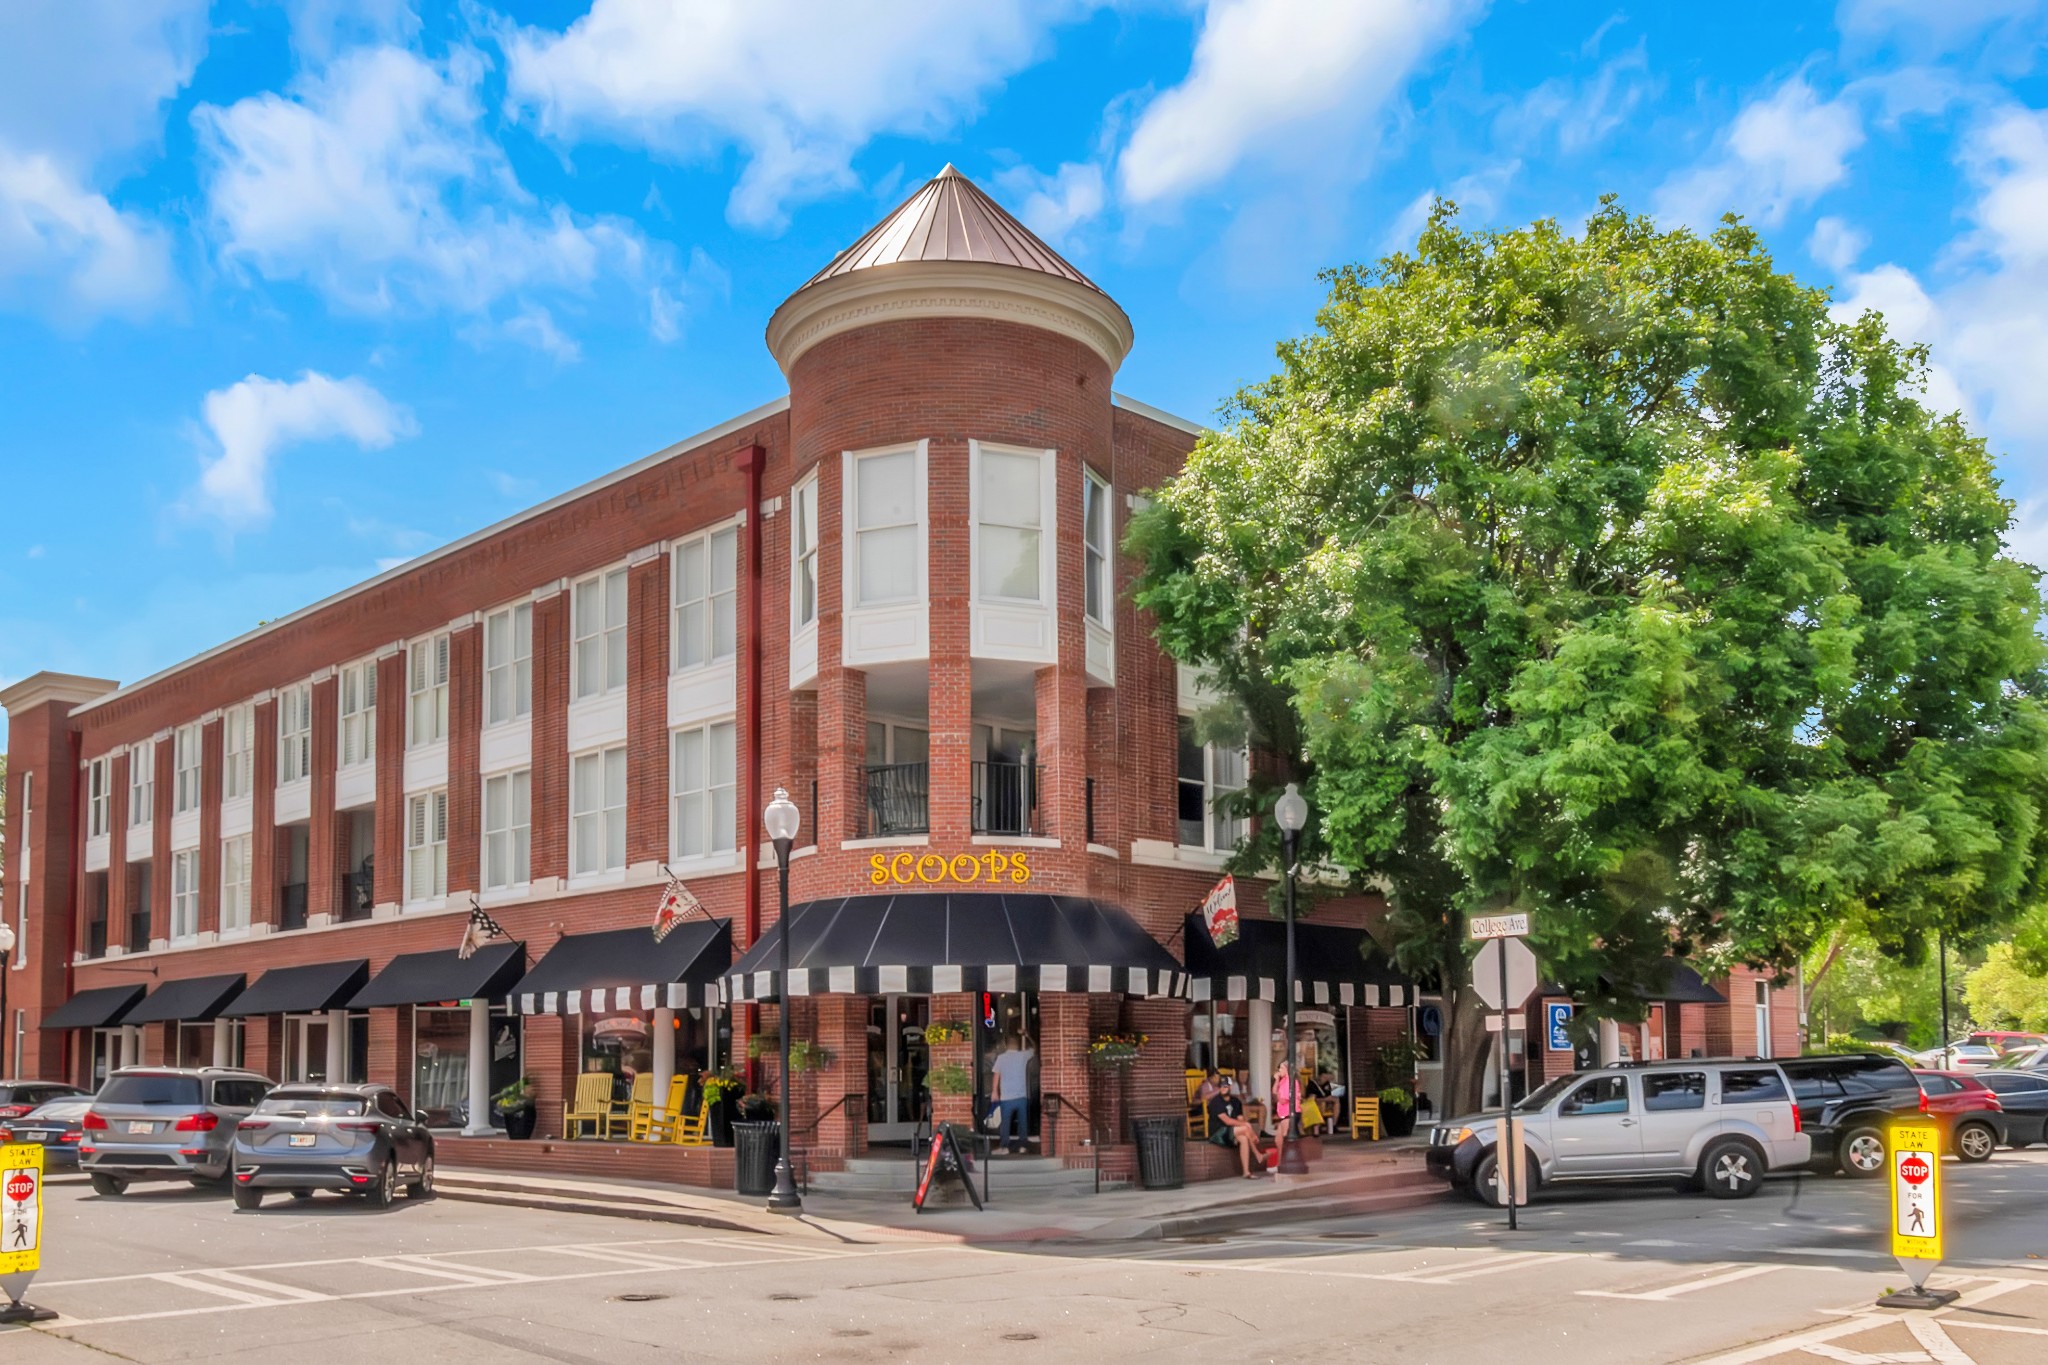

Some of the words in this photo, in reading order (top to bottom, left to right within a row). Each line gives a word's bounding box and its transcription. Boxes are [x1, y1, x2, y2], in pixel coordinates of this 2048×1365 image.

[870, 849, 1030, 885] SCOOPS
[1472, 919, 1507, 935] College
[1510, 917, 1525, 930] Ave
[1900, 1131, 1928, 1139] STATE
[9, 1149, 36, 1157] STATE
[1901, 1166, 1929, 1177] STOP
[8, 1182, 34, 1194] STOP
